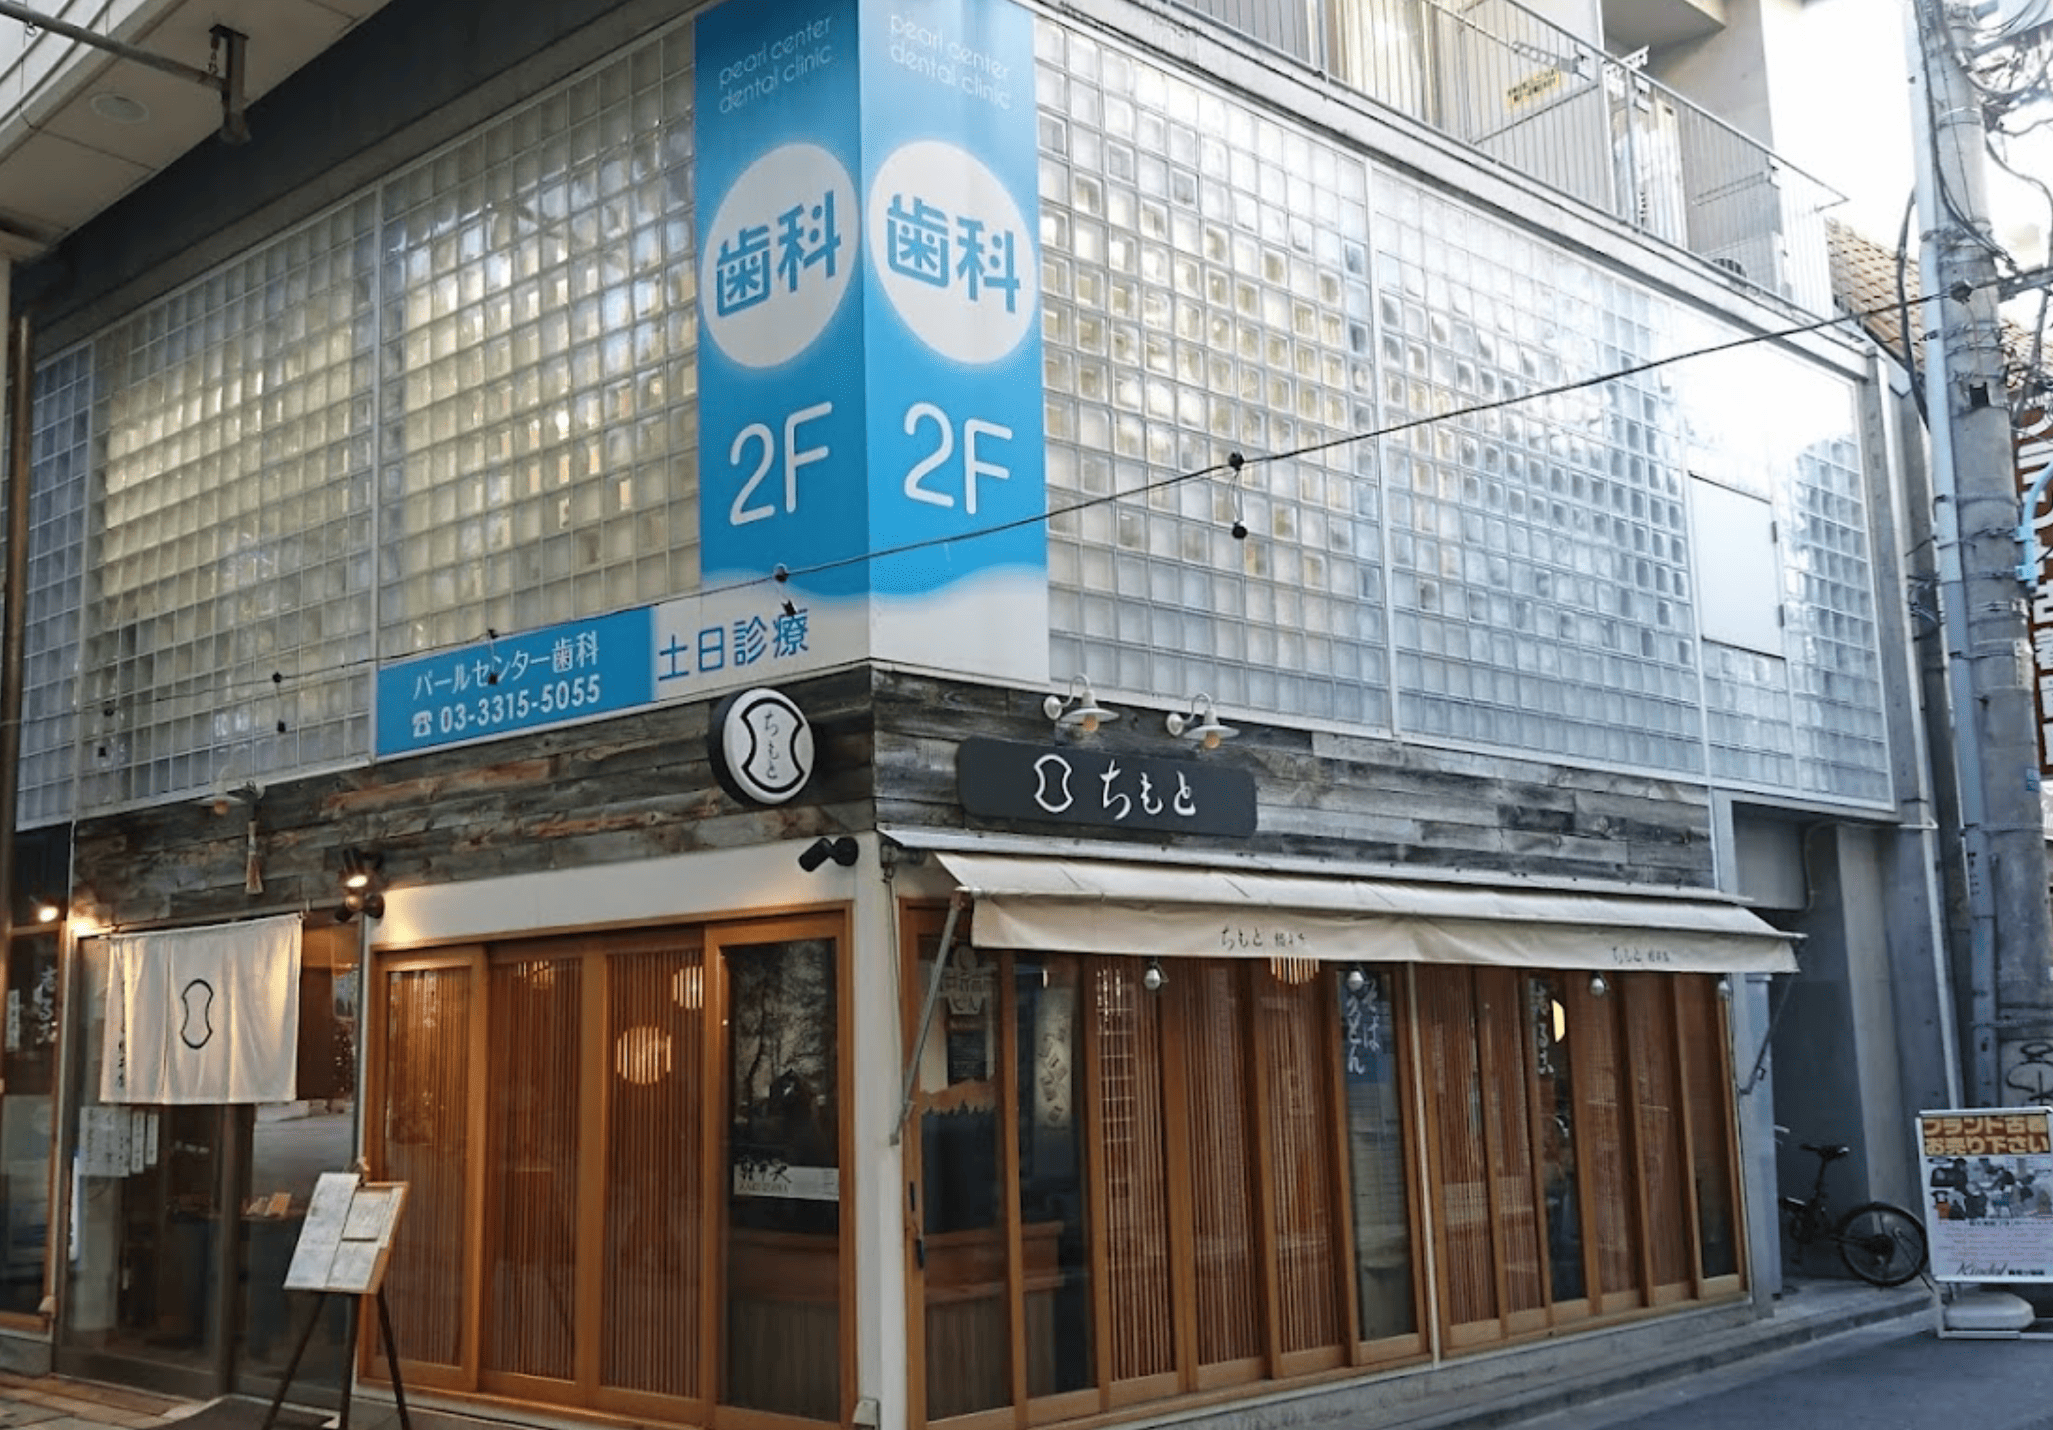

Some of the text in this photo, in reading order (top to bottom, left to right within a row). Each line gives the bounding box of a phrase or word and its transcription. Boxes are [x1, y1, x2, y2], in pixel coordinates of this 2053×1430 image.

[719, 16, 833, 90] pearl center
[719, 44, 833, 115] dental clinic
[889, 13, 1012, 82] pearl center
[889, 42, 1012, 111] dental clinic
[716, 189, 842, 318] 歯科
[887, 193, 1021, 315] 歯科
[730, 401, 833, 526] 2F
[903, 401, 1013, 515] 2F
[413, 629, 599, 700] パールセンター歯科
[658, 607, 809, 682] 土日診療
[440, 673, 600, 733] 03-3315-5055
[764, 709, 780, 780] ちもと
[1100, 758, 1196, 820] ちもと
